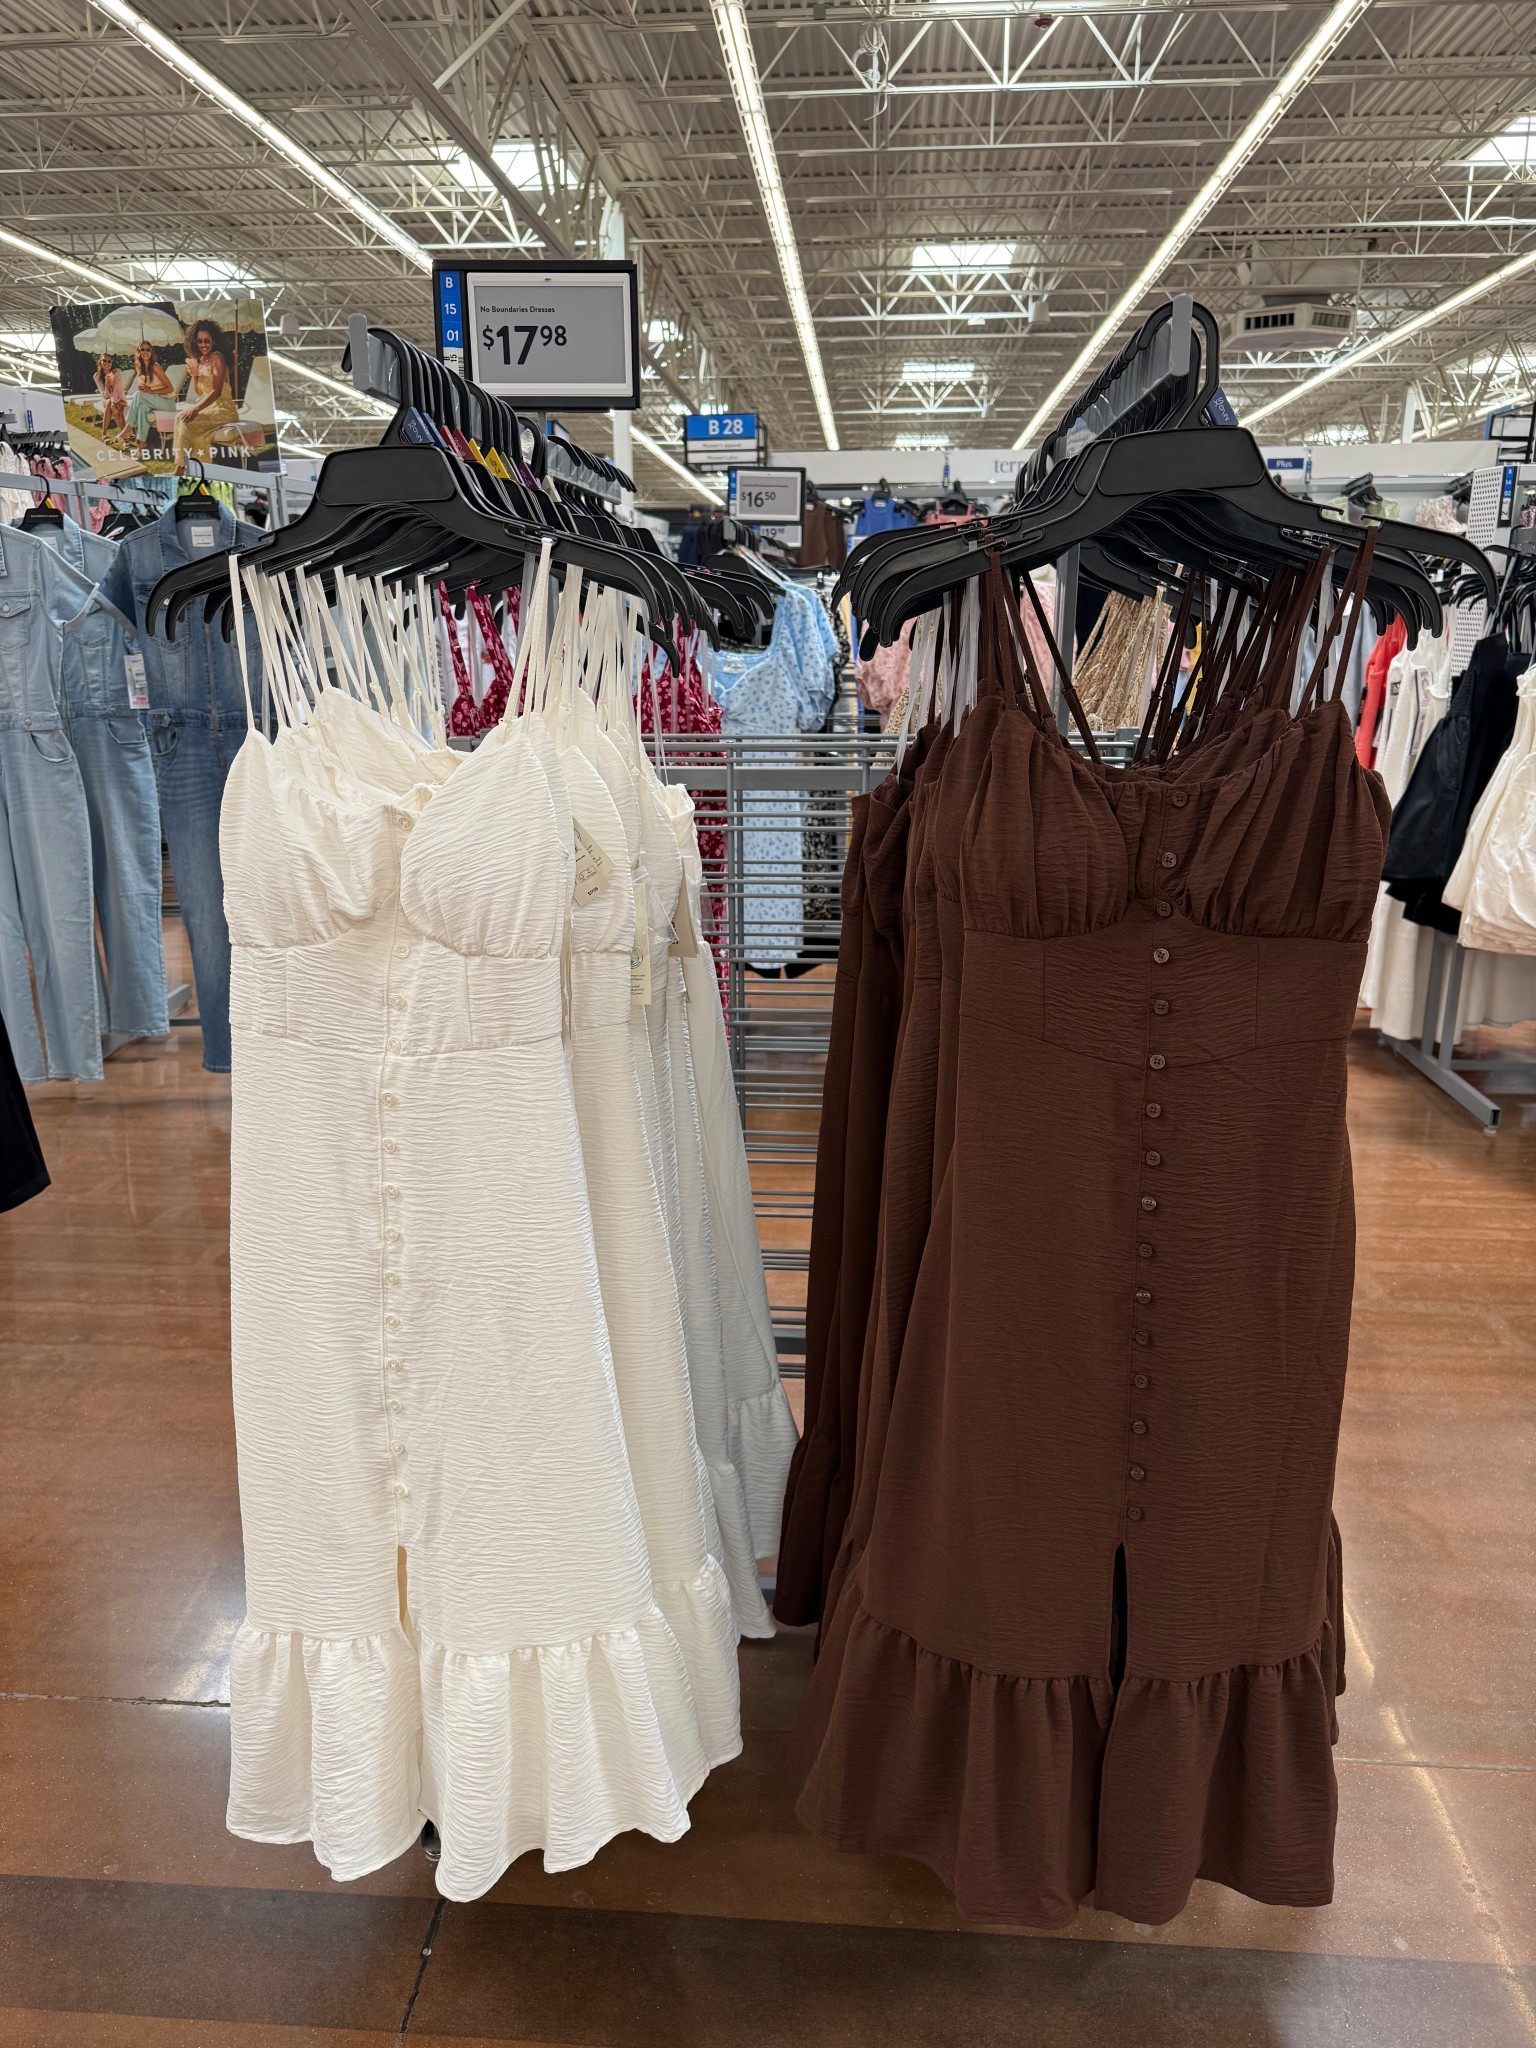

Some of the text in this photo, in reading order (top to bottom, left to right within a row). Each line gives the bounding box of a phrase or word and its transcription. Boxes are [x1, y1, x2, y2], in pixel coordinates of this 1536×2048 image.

[445, 277, 453, 288] B
[444, 304, 457, 314] 15
[446, 330, 459, 341] 01
[708, 419, 744, 435] B 28
[97, 446, 252, 461] CELEBRITY PINK
[1276, 460, 1294, 468] Plus
